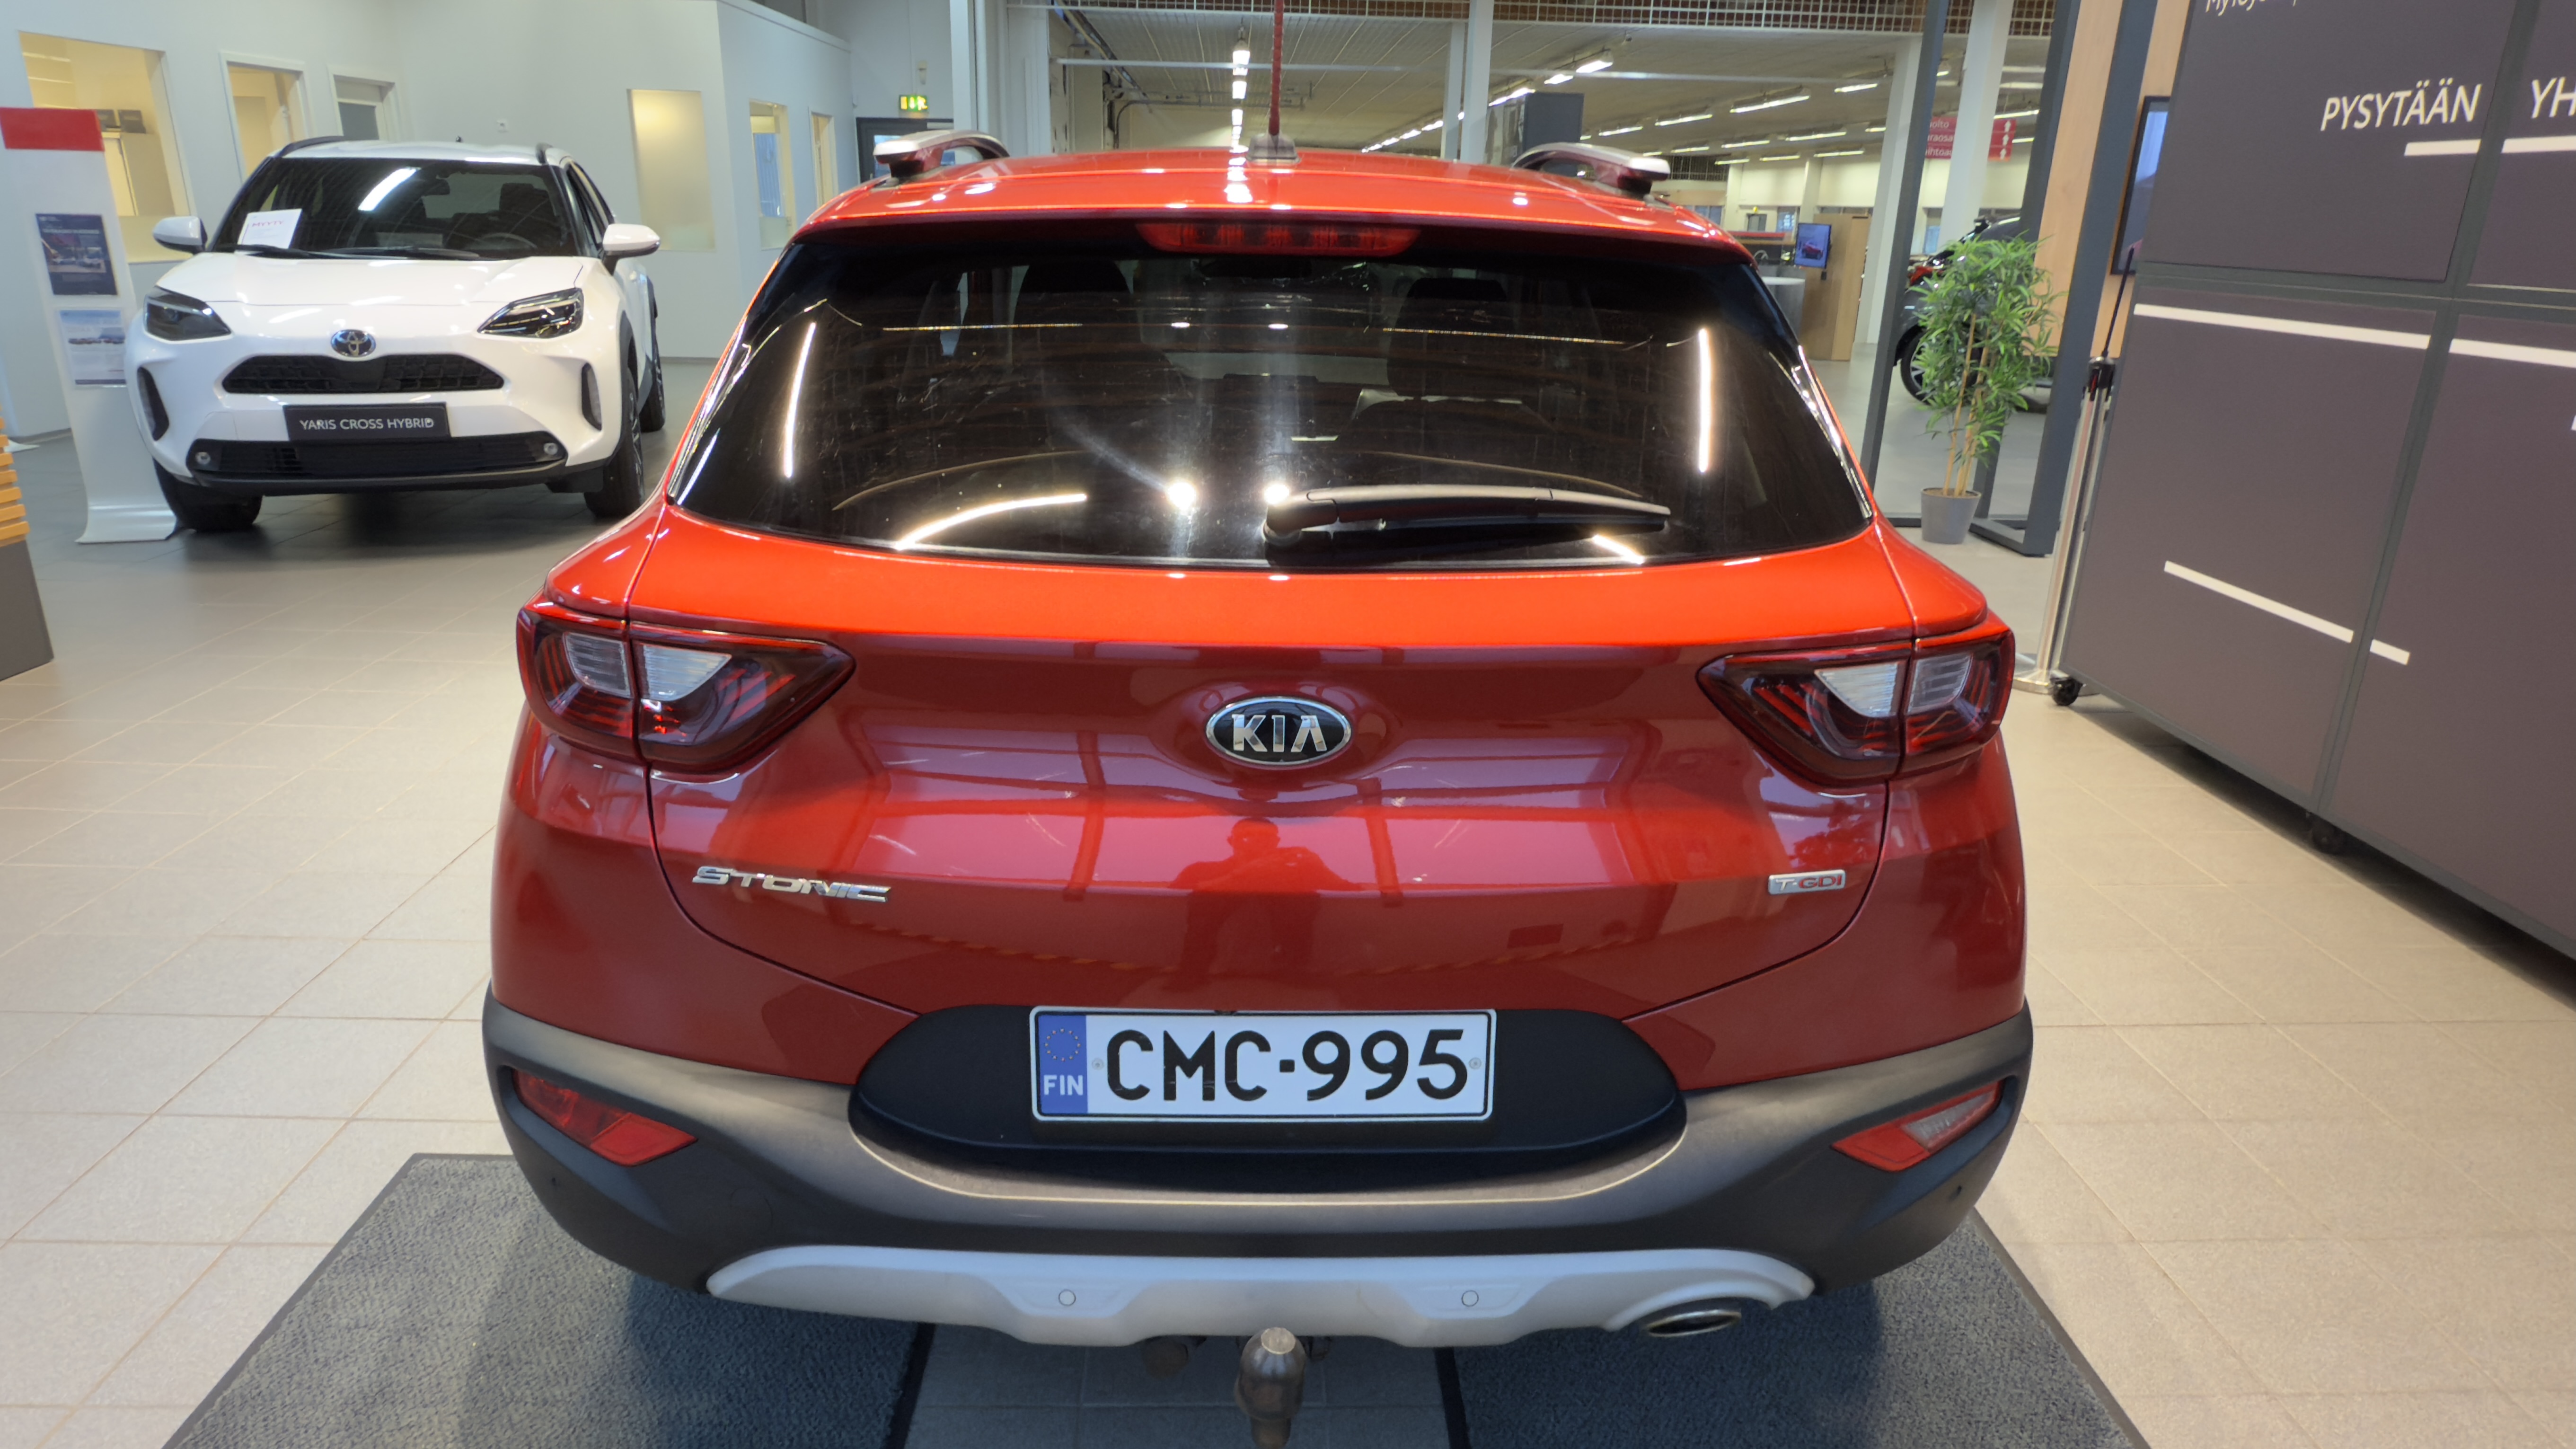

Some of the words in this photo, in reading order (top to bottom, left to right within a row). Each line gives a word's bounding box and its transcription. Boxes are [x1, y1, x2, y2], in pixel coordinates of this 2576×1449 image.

[2320, 77, 2482, 131] PYSYTÄÄN
[1927, 134, 1954, 142] raosa
[300, 419, 336, 430] YARIS
[340, 418, 384, 430] CROSS
[387, 417, 434, 429] HYBRID
[1232, 714, 1327, 752] KIA
[692, 866, 891, 902] STONIC
[1775, 874, 1842, 891] T-GDI
[1043, 1074, 1083, 1096] FIN
[1106, 1029, 1468, 1101] CMC-995
